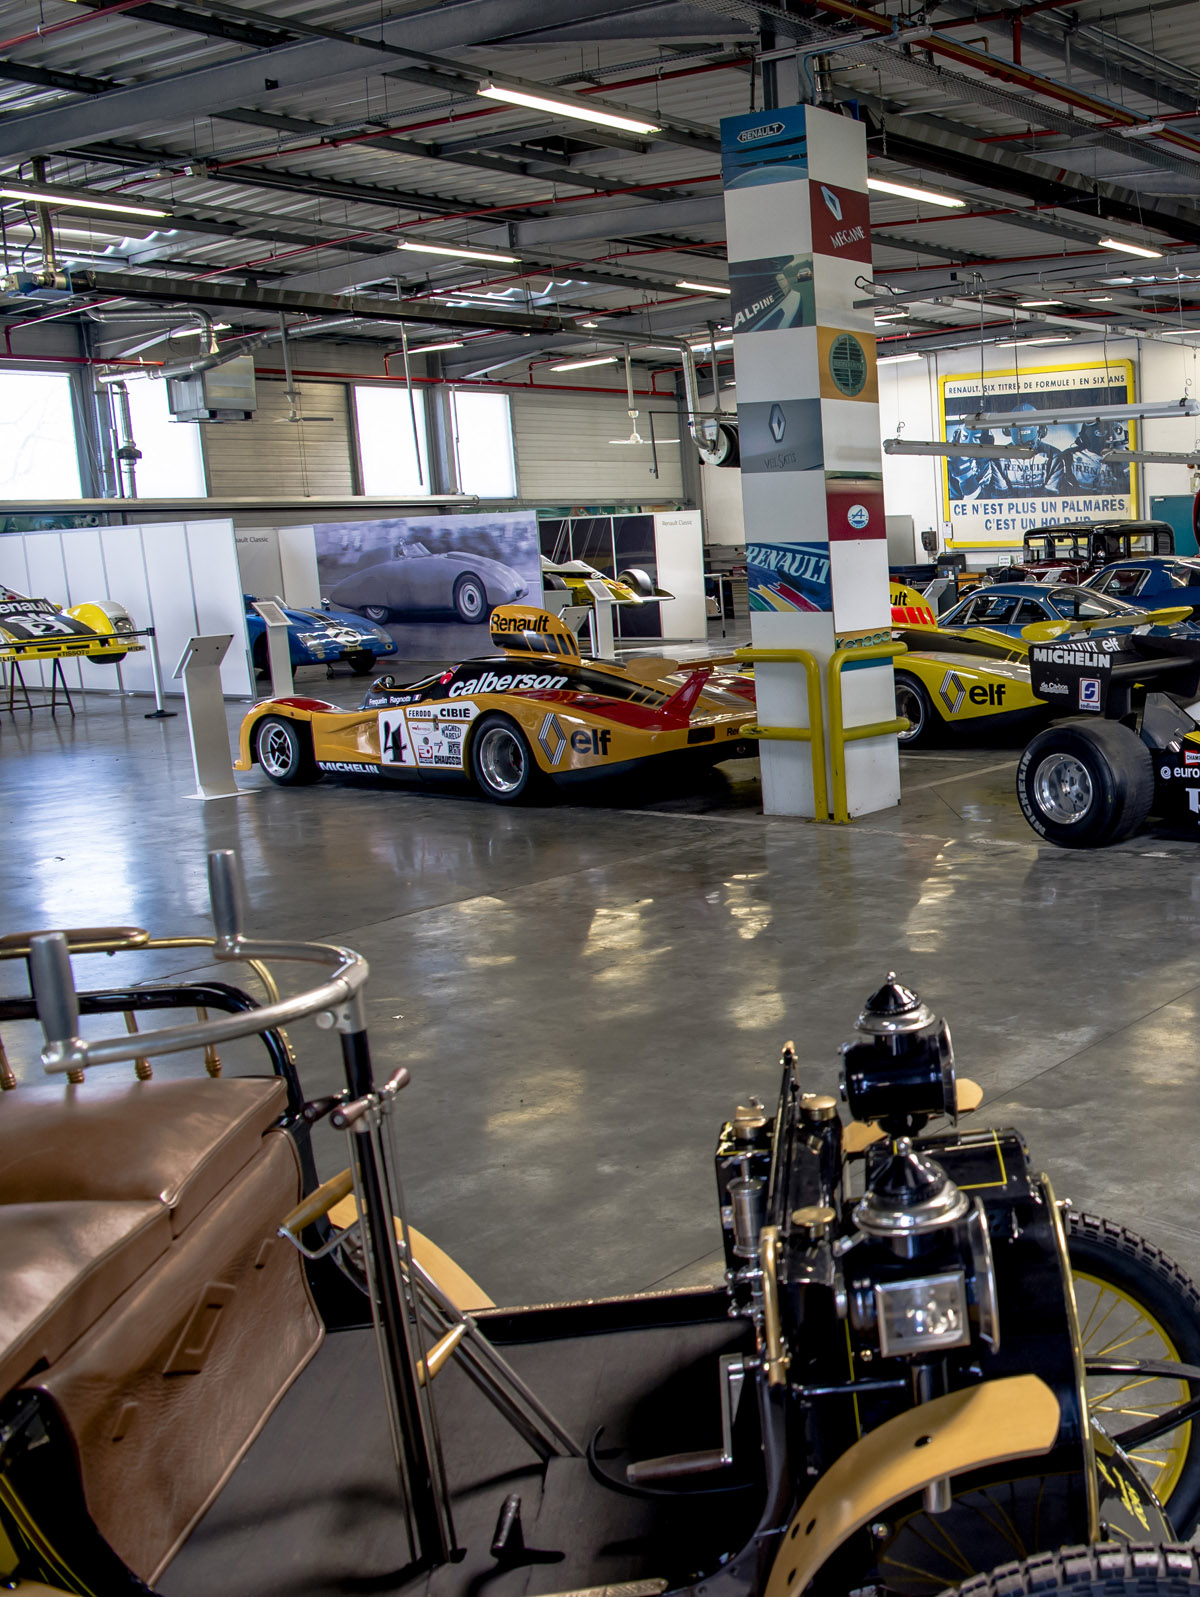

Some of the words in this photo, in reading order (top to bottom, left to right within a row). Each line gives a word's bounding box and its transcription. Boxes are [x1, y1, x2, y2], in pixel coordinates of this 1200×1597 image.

[741, 124, 780, 142] RENAULT
[829, 226, 867, 249] MEGANE
[734, 294, 775, 329] ALPINE
[948, 386, 981, 394] RENAULT.
[983, 384, 996, 392] SIX
[998, 382, 1020, 391] TITRES
[1023, 381, 1033, 389] DE
[1035, 379, 1070, 388] FORMULE
[1079, 377, 1090, 386] EN
[1092, 376, 1105, 384] SIX
[1108, 375, 1125, 383] ANS
[953, 504, 967, 516] CE
[972, 503, 1003, 516] N'EST
[1008, 501, 1036, 514] PLUS
[1041, 501, 1057, 513] UN
[984, 517, 1017, 531] C'EST
[1020, 517, 1036, 530] UN
[747, 545, 830, 585] RENAULT
[490, 614, 550, 633] Renault
[1102, 638, 1121, 652] elf
[1033, 648, 1111, 669] MICHELIN
[449, 672, 569, 698] calberson
[969, 683, 1006, 706] elf
[408, 710, 432, 718] FERODO
[383, 721, 407, 763] 4
[570, 729, 611, 756] elf
[318, 761, 380, 774] MICHELIN
